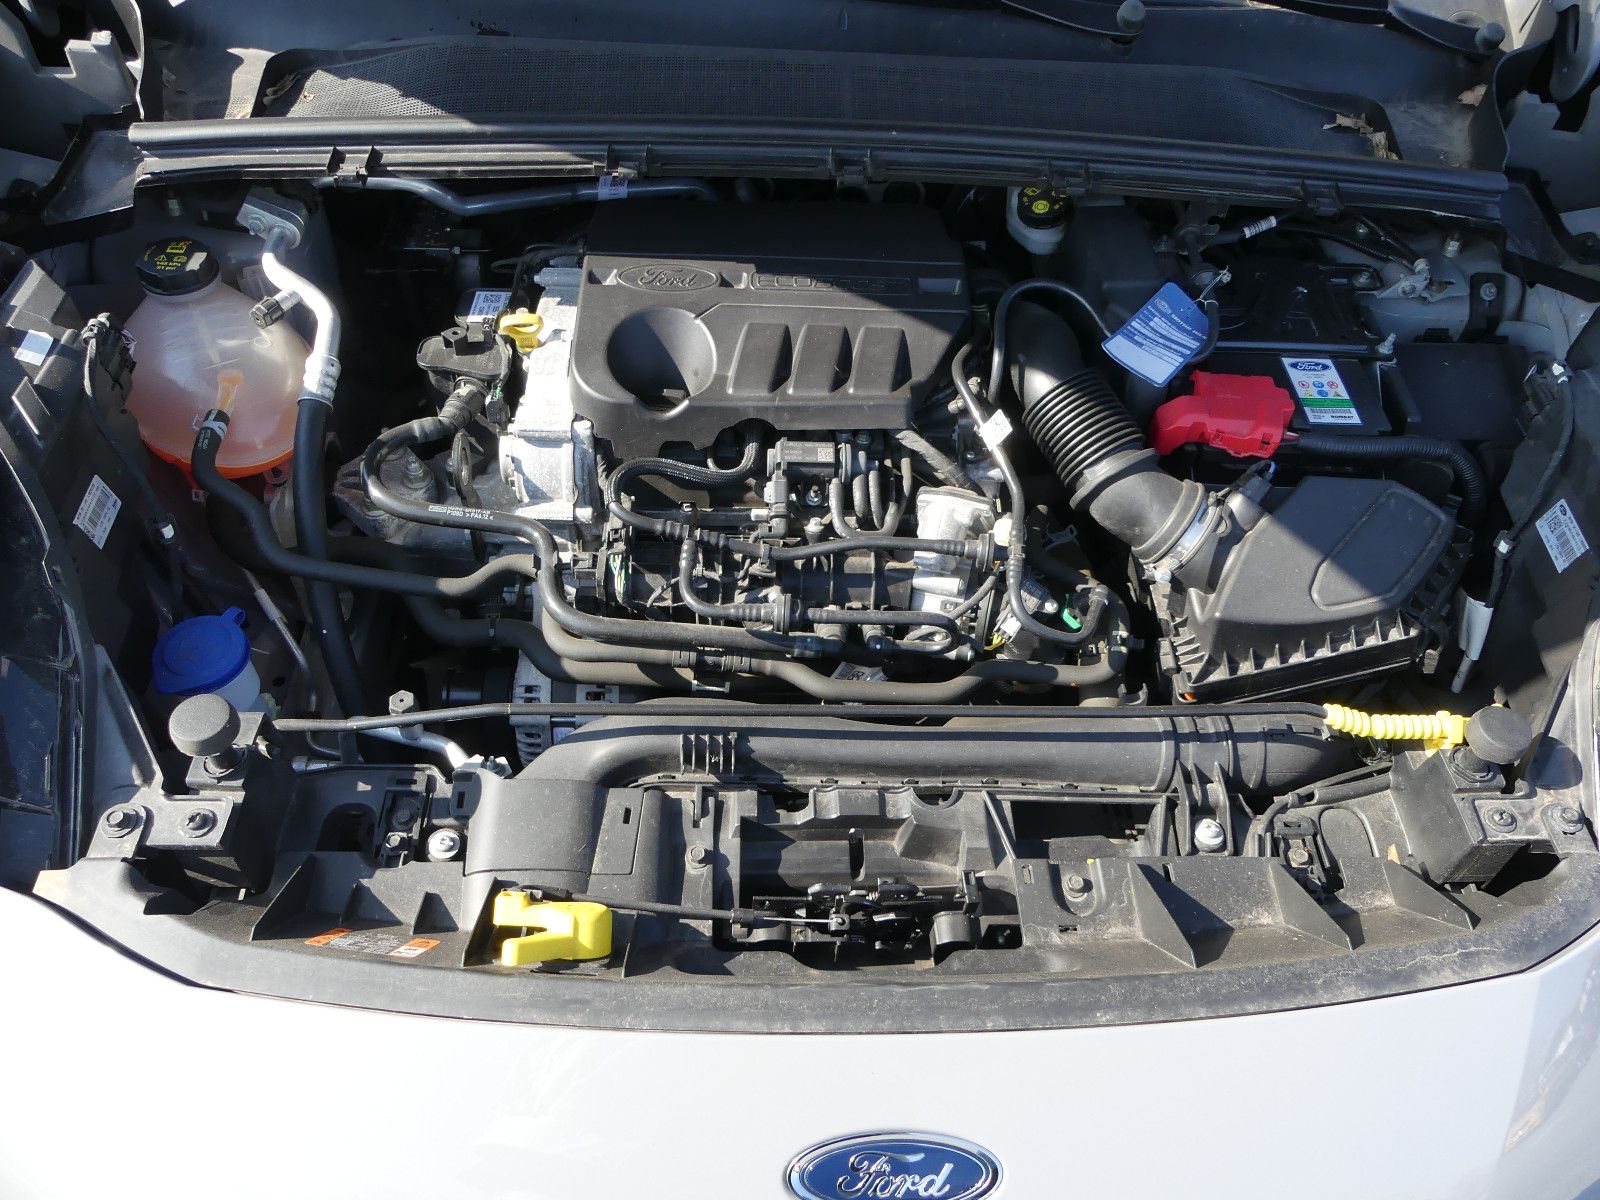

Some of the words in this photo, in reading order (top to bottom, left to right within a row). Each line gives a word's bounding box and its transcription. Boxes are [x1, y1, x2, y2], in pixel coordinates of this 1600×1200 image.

[637, 268, 698, 287] Ford
[1296, 361, 1323, 371] Ford
[836, 1151, 954, 1198] Ford
